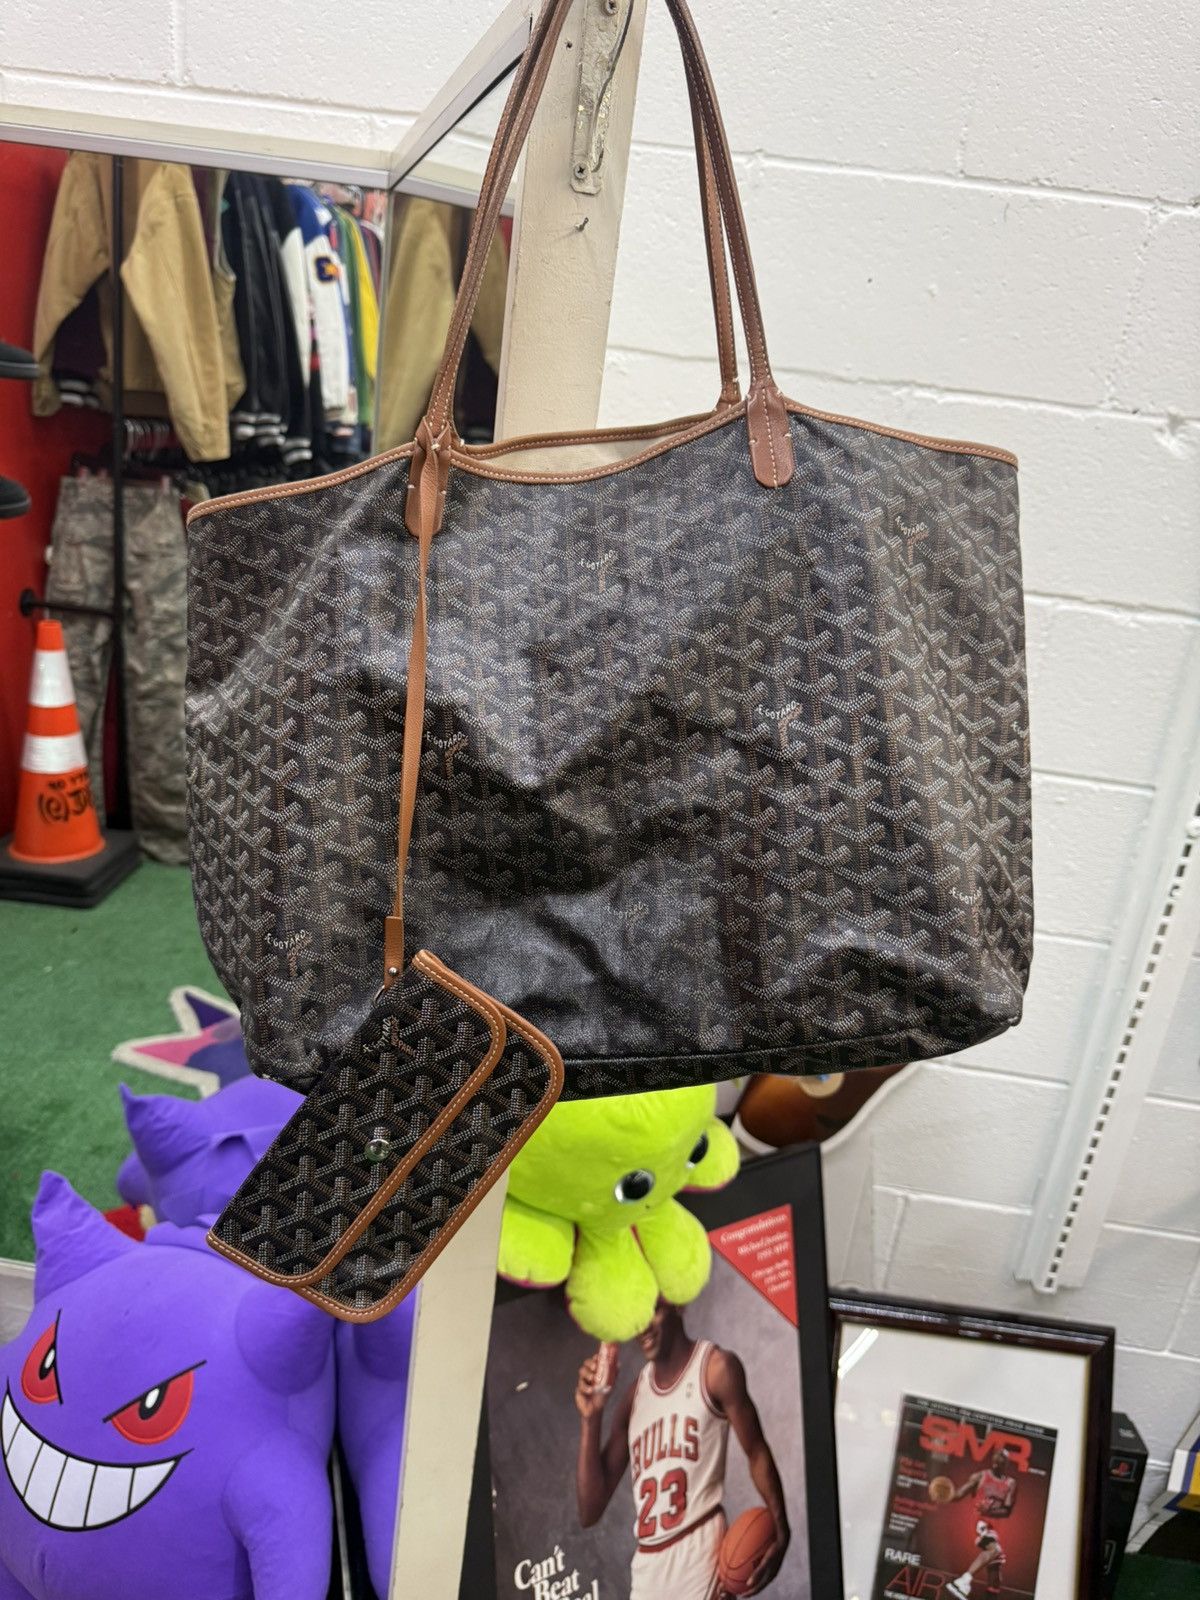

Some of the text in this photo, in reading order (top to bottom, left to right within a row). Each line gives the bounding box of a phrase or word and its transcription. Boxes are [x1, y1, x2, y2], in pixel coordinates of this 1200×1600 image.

[631, 1413, 699, 1484] BULLS
[919, 1414, 1032, 1473] SMR
[638, 1467, 688, 1539] 23
[514, 1544, 565, 1590] Can't
[884, 1547, 921, 1566] RARE
[533, 1568, 580, 1600] Beat
